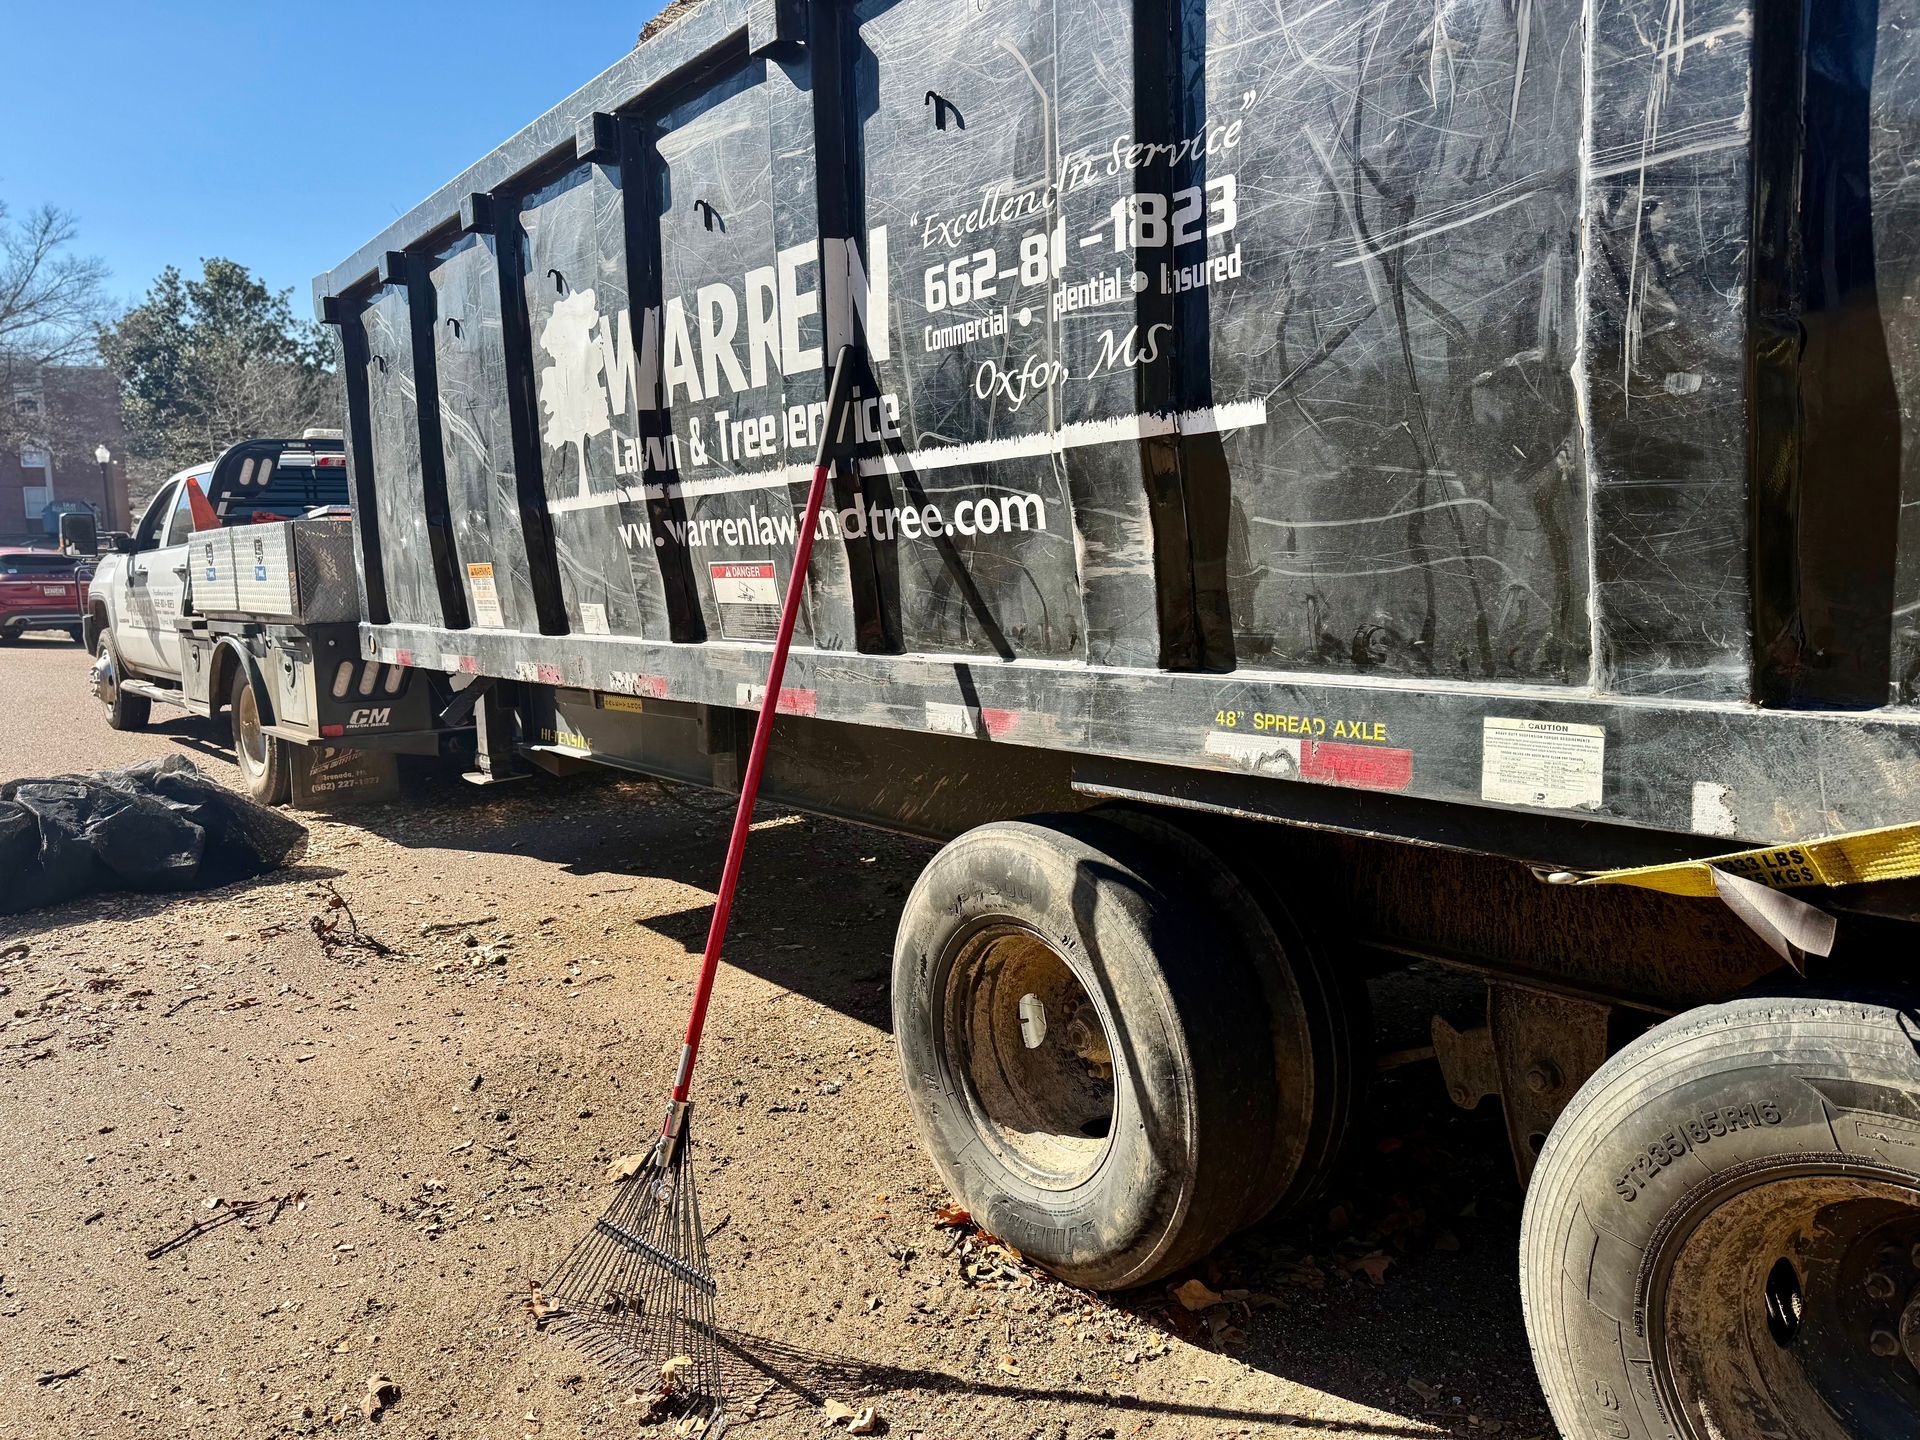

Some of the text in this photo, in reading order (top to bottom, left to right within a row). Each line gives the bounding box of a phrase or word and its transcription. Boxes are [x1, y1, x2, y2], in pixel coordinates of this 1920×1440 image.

[924, 306, 1008, 352] Commercial
[1160, 244, 1242, 294] Insured
[599, 225, 890, 416] WARREN
[1088, 322, 1172, 380] MS
[611, 430, 682, 476] Lawn
[689, 418, 709, 466] &
[715, 410, 777, 463] Tree
[731, 566, 761, 577] DANGER
[349, 707, 391, 725] CM
[1253, 712, 1326, 736] SPREAD
[1333, 719, 1386, 741] AXLE
[1528, 721, 1569, 733] CAUTION
[1762, 849, 1804, 868] LBS
[1770, 866, 1815, 884] KGS
[1614, 1100, 1783, 1203] ST235/85R16
